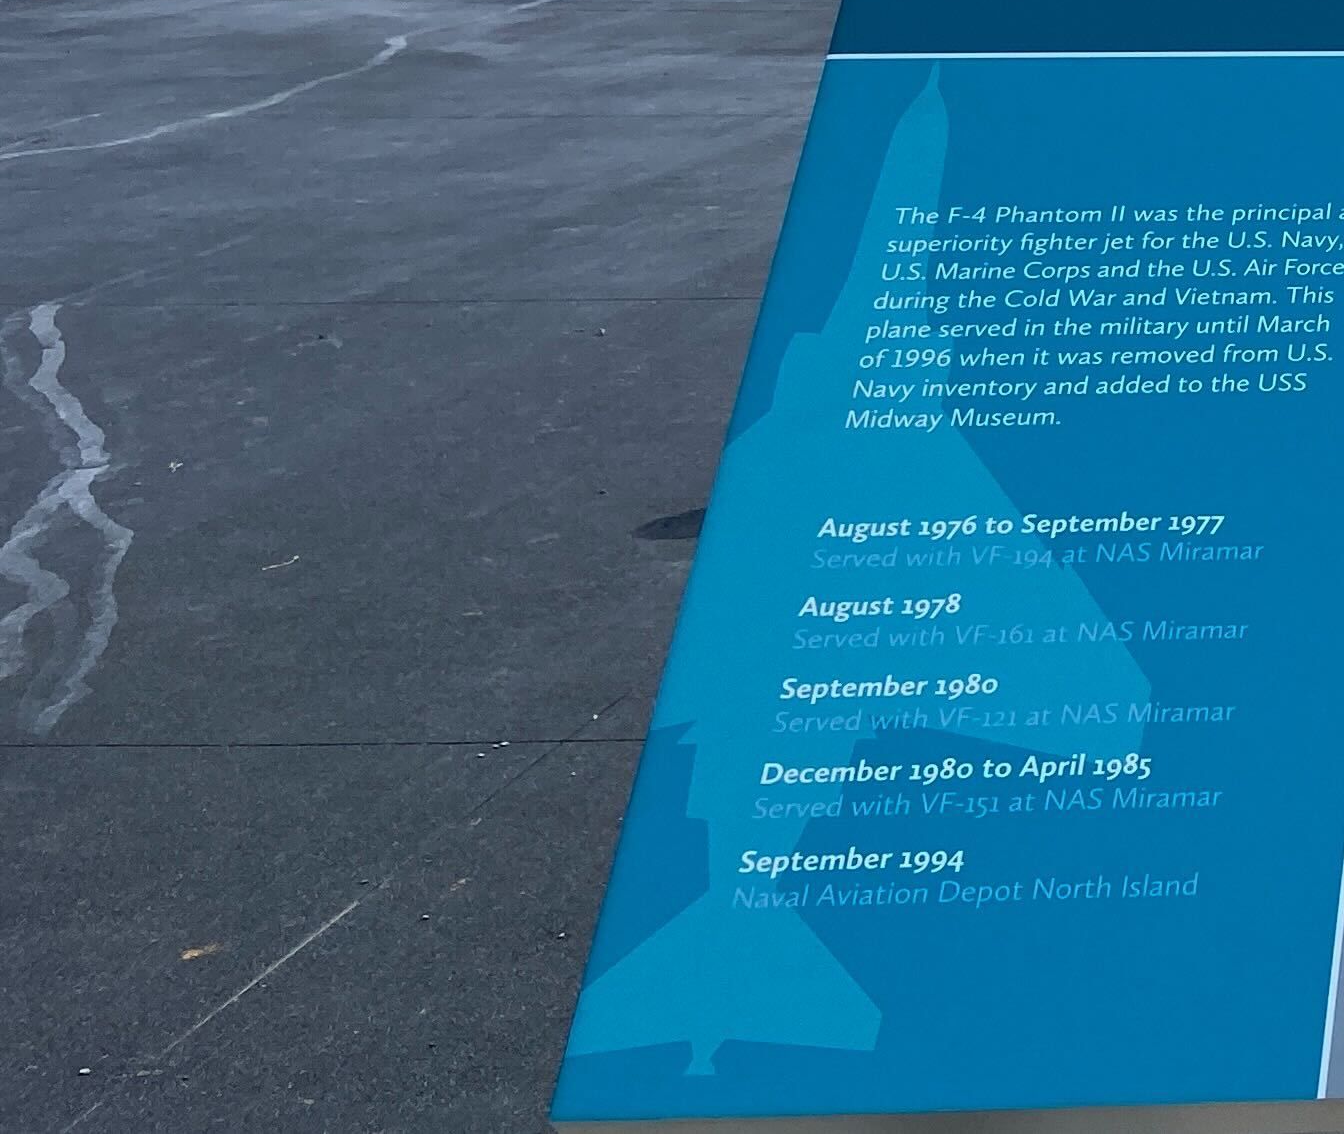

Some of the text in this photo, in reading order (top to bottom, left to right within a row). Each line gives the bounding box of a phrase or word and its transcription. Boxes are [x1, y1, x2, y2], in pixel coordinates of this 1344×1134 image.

[896, 206, 939, 224] The
[948, 206, 986, 224] F-4
[995, 205, 1102, 223] Phantom
[1111, 205, 1126, 222] II
[1134, 209, 1178, 222] was
[1187, 204, 1224, 222] the
[1232, 202, 1332, 226] principal
[886, 230, 1343, 257] superiority fighter jet for the U.S. Navy,
[882, 258, 1344, 284] U.S. Marine Corps and the U.S. Air Force
[874, 285, 1334, 314] during the Cold War and Vietnam. This
[865, 314, 1330, 344] plane served in the military until March
[859, 343, 1333, 368] of 1996 when it was removed from U.S.
[853, 372, 1307, 403] Navy inventory and added to the USS
[845, 408, 1061, 433] Midway Museum.
[817, 511, 1225, 543] August 1976 to September 1977
[798, 593, 962, 622] August 1978
[780, 673, 998, 704] September 1980
[760, 752, 1152, 786] December 1980 to April 1985
[752, 787, 1222, 818] Served with VF-151 at NAS Miramar
[738, 846, 964, 879] September 1994
[732, 873, 1198, 908] Naval Aviation Depot North Island
